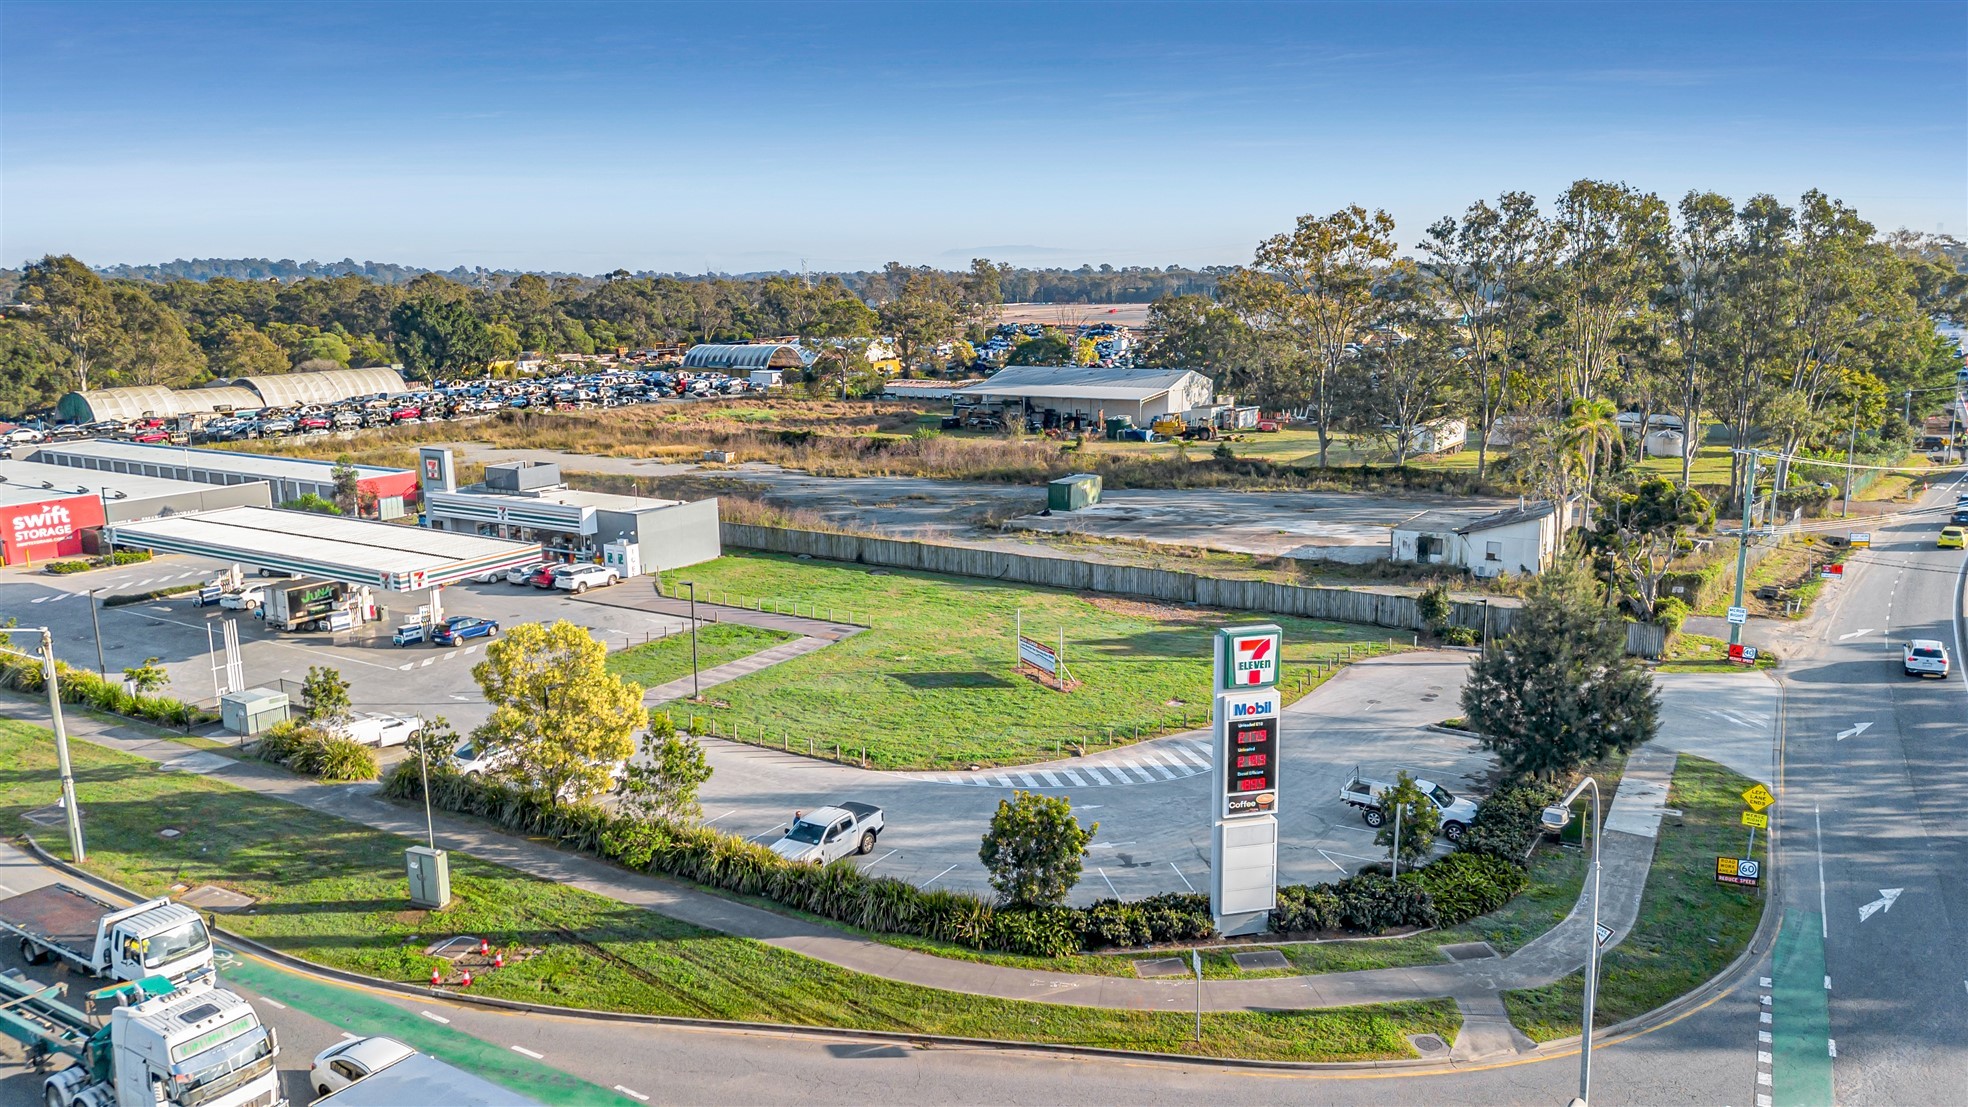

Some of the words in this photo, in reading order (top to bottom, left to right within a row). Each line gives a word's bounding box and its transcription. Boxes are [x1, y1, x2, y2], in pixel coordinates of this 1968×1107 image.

[13, 505, 71, 530] swift
[15, 524, 72, 541] STORAGE
[414, 571, 424, 587] 7
[1240, 638, 1270, 684] 7
[1234, 701, 1272, 716] Mobil
[1229, 801, 1256, 809] Coffee
[1742, 865, 1755, 873] 60
